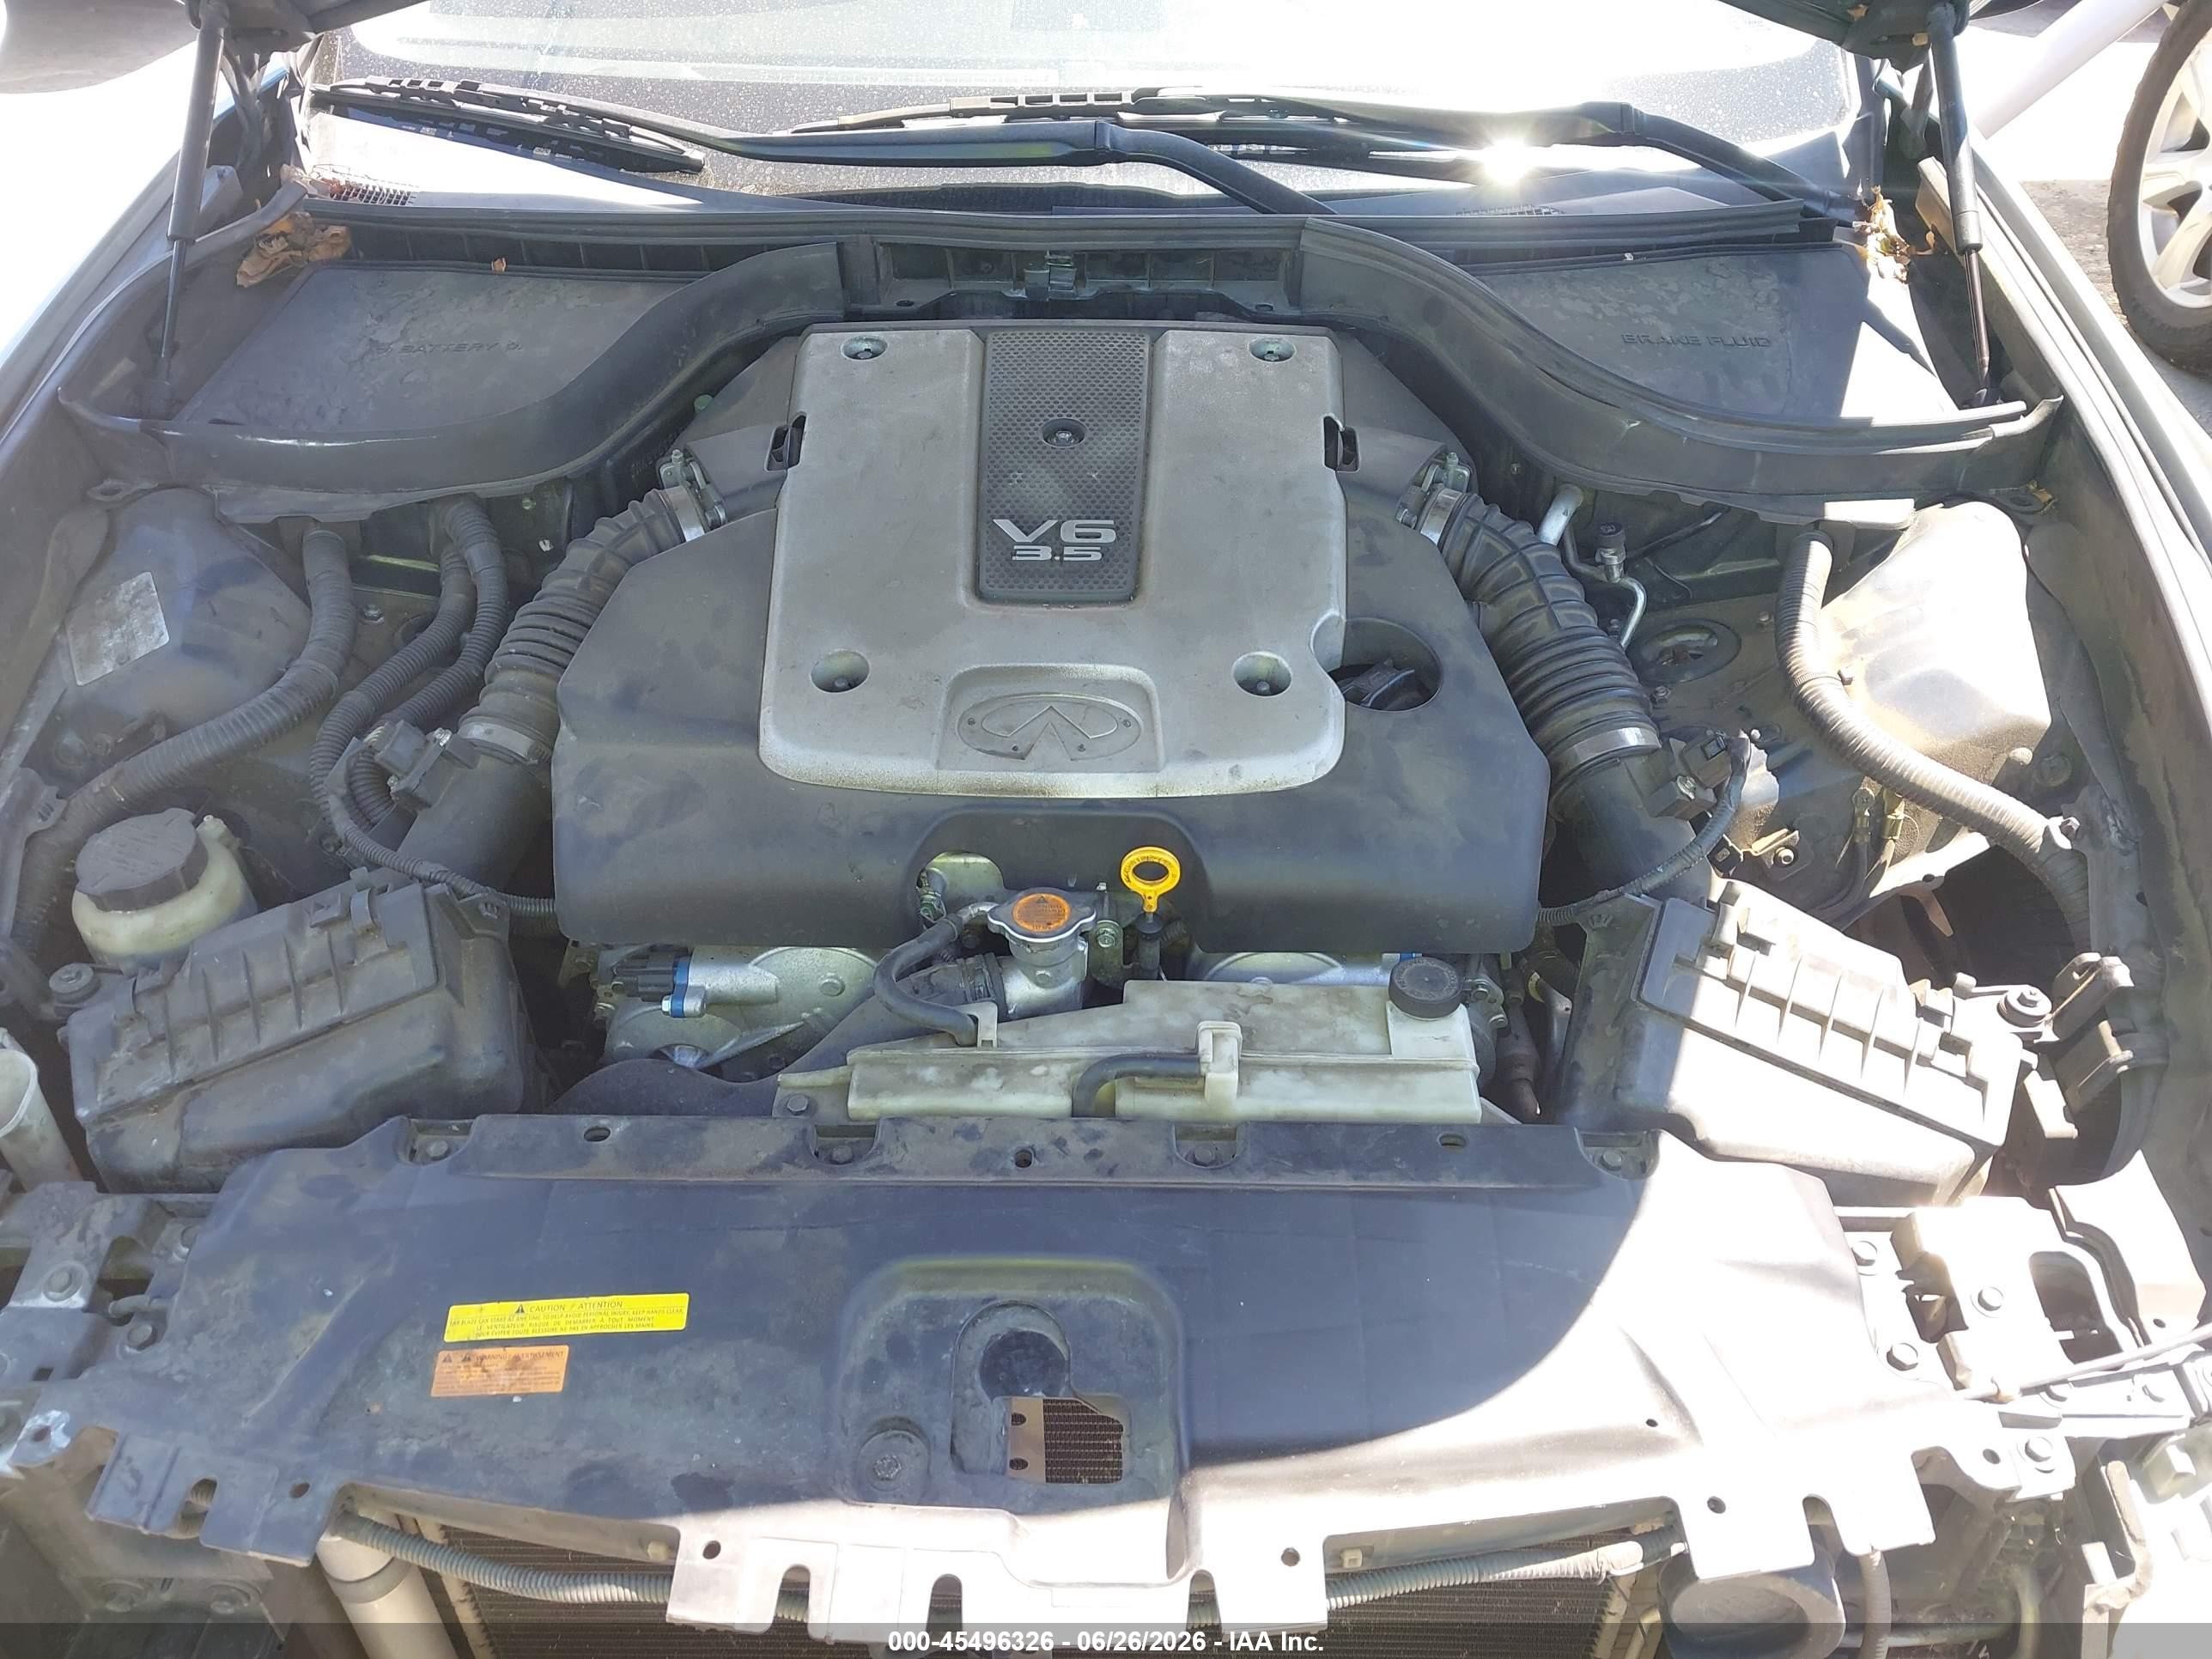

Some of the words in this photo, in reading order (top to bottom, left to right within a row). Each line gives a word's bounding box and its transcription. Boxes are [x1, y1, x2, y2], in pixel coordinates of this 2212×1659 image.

[1621, 334, 1701, 345] BRAKE
[1706, 335, 1771, 347] FLUID
[398, 341, 501, 354] BATTERY
[993, 519, 1116, 544] V6
[1012, 545, 1103, 561] 3.5
[529, 1304, 566, 1313] CAUTION
[578, 1301, 623, 1310] ATTENTION
